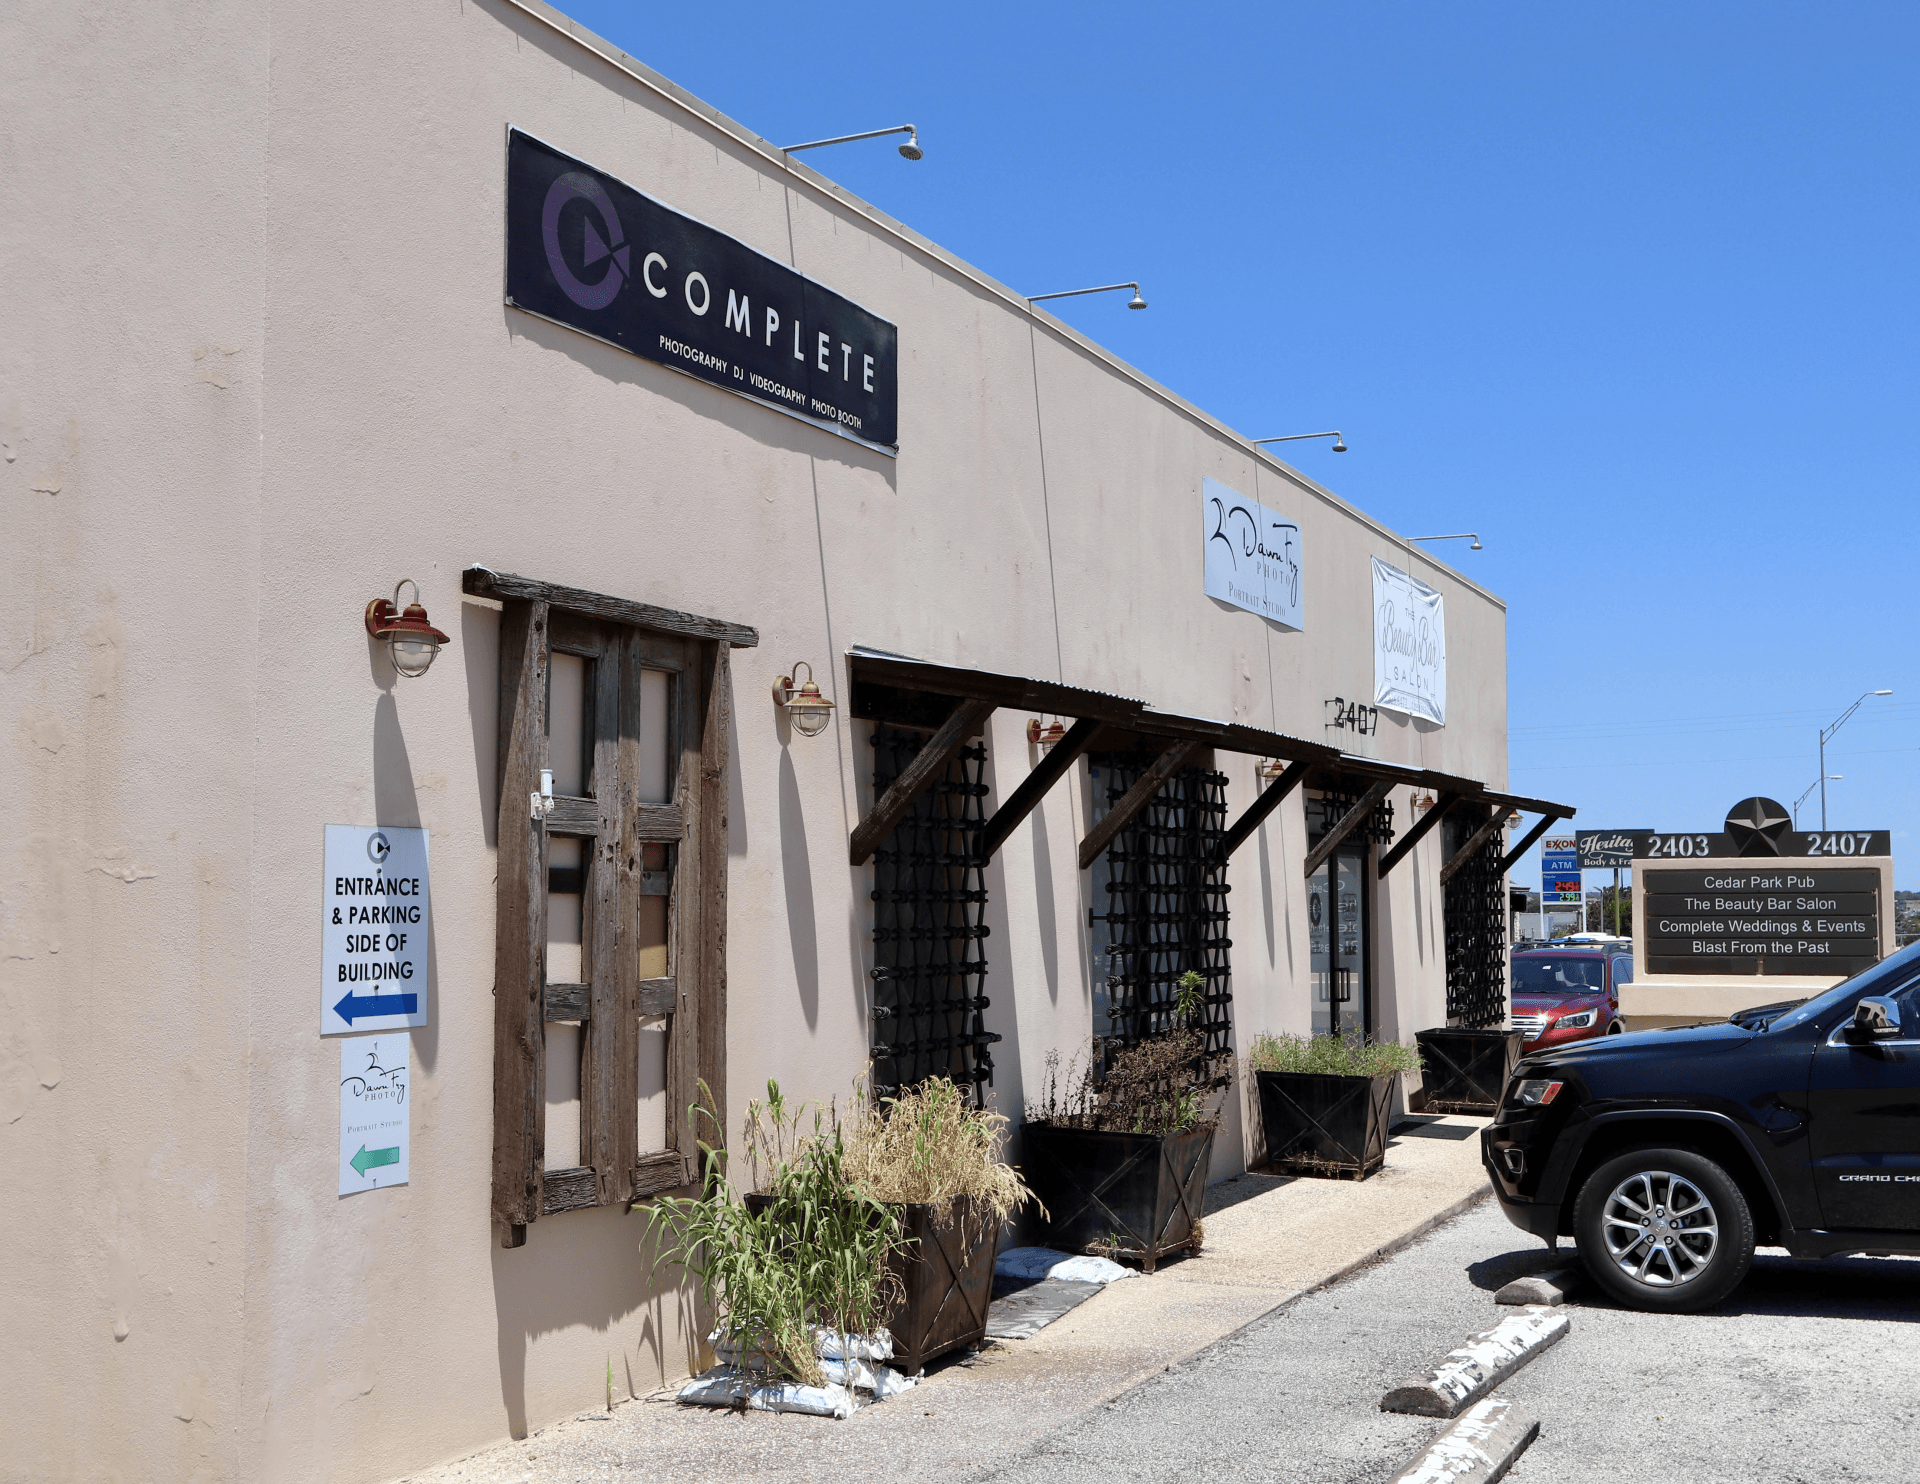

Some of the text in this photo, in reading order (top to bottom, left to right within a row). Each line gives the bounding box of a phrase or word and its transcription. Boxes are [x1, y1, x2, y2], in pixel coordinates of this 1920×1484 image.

[643, 252, 874, 393] COMPLETE
[659, 335, 862, 429] PHOTOGRAPHY DJ VIDEOGRAPHY PHOTO BOOTH
[1257, 561, 1290, 586] PHOTO
[1382, 600, 1417, 673] Beauty
[1394, 666, 1429, 692] SALON
[1334, 697, 1378, 737] 2407
[1546, 840, 1576, 850] EXXON
[1648, 833, 1872, 857] 2403 2407
[1584, 858, 1607, 867] Body
[1609, 858, 1617, 866] &
[335, 877, 420, 896] ENTRANCE
[1704, 875, 1815, 889] Cedar Park Pub
[1684, 897, 1837, 913] The Beauty Bar Salon
[332, 906, 421, 925] & PARKING
[1659, 920, 1866, 935] Complete Weddings & Events
[346, 933, 407, 953] SIDE OF
[1692, 941, 1830, 954] Blast From the Past
[338, 961, 413, 982] BUILDING
[364, 1091, 396, 1101] PHOTO
[1839, 1174, 1891, 1182] GRAND
